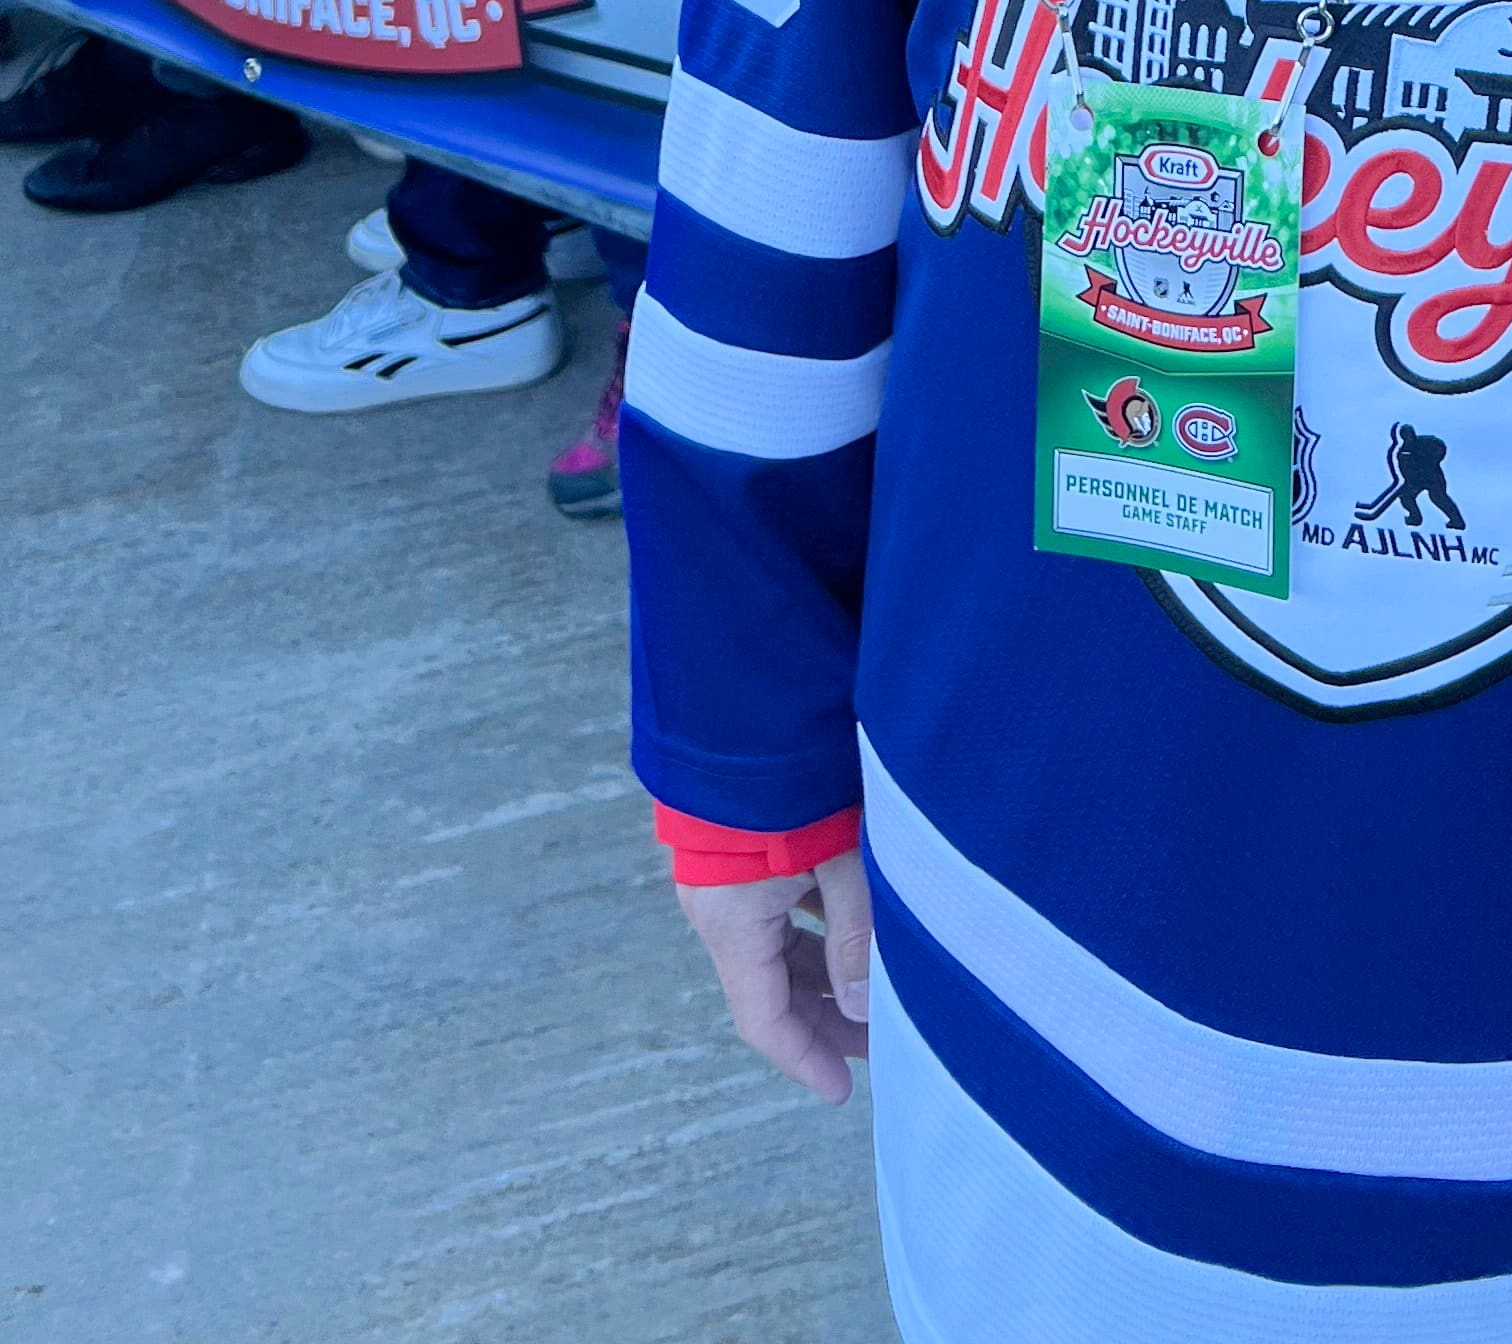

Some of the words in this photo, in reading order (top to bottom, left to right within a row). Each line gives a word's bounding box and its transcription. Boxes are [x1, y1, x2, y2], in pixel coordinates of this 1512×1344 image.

[1159, 156, 1200, 179] Kraft
[1061, 198, 1282, 270] Hockeyville
[1107, 304, 1222, 344] SAINT-BONIFACE,
[1222, 326, 1242, 344] QC
[1066, 474, 1170, 508] PERSONNEL
[1177, 493, 1198, 514] DE
[1204, 499, 1263, 530] MATCH
[1123, 504, 1161, 525] GAME
[1166, 512, 1208, 534] STAFF
[1302, 521, 1335, 546] MD
[1341, 522, 1468, 562] AJLNH
[1471, 546, 1499, 566] MC
